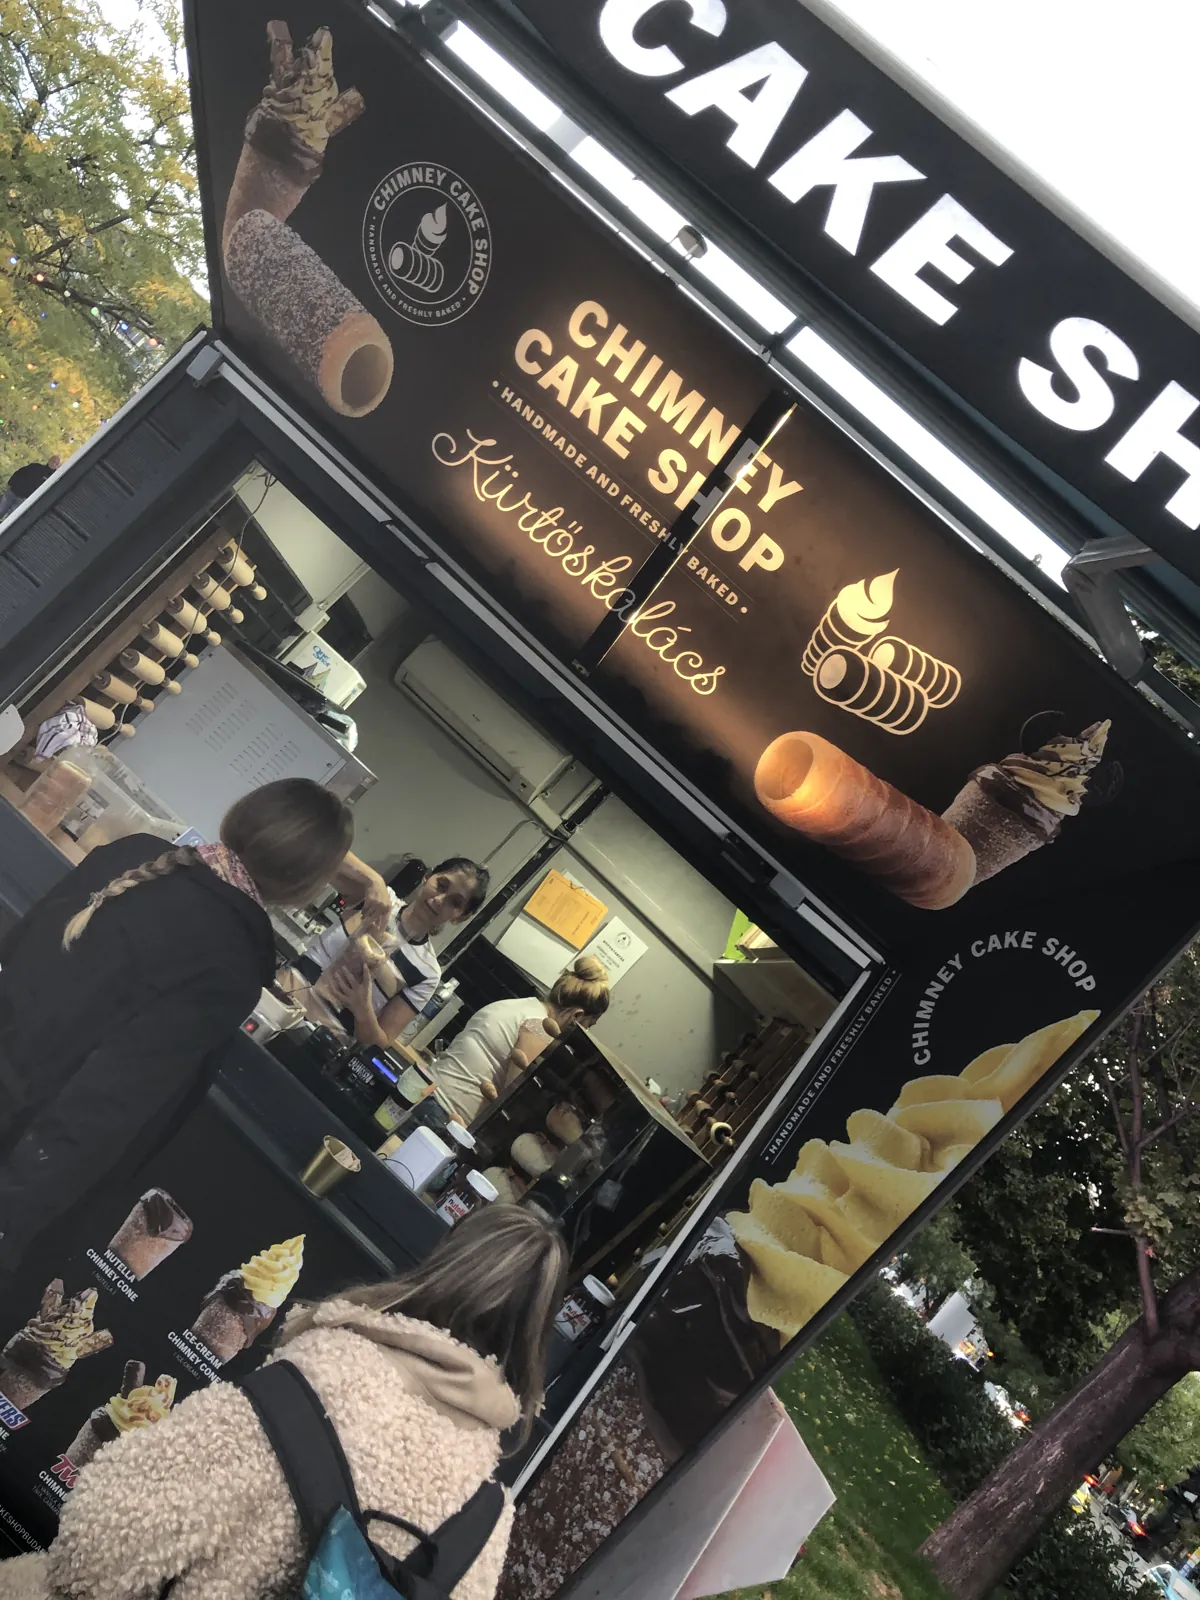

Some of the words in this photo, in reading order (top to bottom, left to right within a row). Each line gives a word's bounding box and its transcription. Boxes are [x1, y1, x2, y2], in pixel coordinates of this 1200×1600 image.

[598, 0, 1015, 326] CAKE
[369, 224, 383, 281] HANDMADE
[382, 283, 397, 300] AND
[398, 300, 433, 318] FRESHLY
[436, 302, 461, 317] BAKED
[374, 167, 447, 211] CHIMNEY
[450, 181, 485, 232] CAKE
[468, 238, 489, 295] SHOP
[514, 328, 648, 459] CAKE
[647, 448, 785, 572] SHOP
[568, 300, 804, 513] CHIMNEY
[432, 429, 726, 696] Kürtőskalács
[501, 387, 585, 468] HANDMADE
[586, 466, 620, 497] AND
[620, 495, 688, 558] FRESHLY
[687, 557, 739, 606] BAKED
[911, 953, 963, 1066] CHIMNEY
[970, 930, 1036, 957] CAKE
[1041, 937, 1096, 994] SHOP
[768, 1089, 815, 1155] HANDMADE
[813, 1064, 832, 1090] AND
[830, 1015, 865, 1064] FRESHLY
[864, 976, 892, 1016] BAKED
[103, 1249, 136, 1283] NUTELLA
[449, 1198, 465, 1215] nutell
[86, 1248, 120, 1282] CHIMNEY
[117, 1279, 139, 1302] CONE
[167, 1331, 201, 1365] CHIMNEY
[182, 1328, 222, 1369] ICE-CREAM
